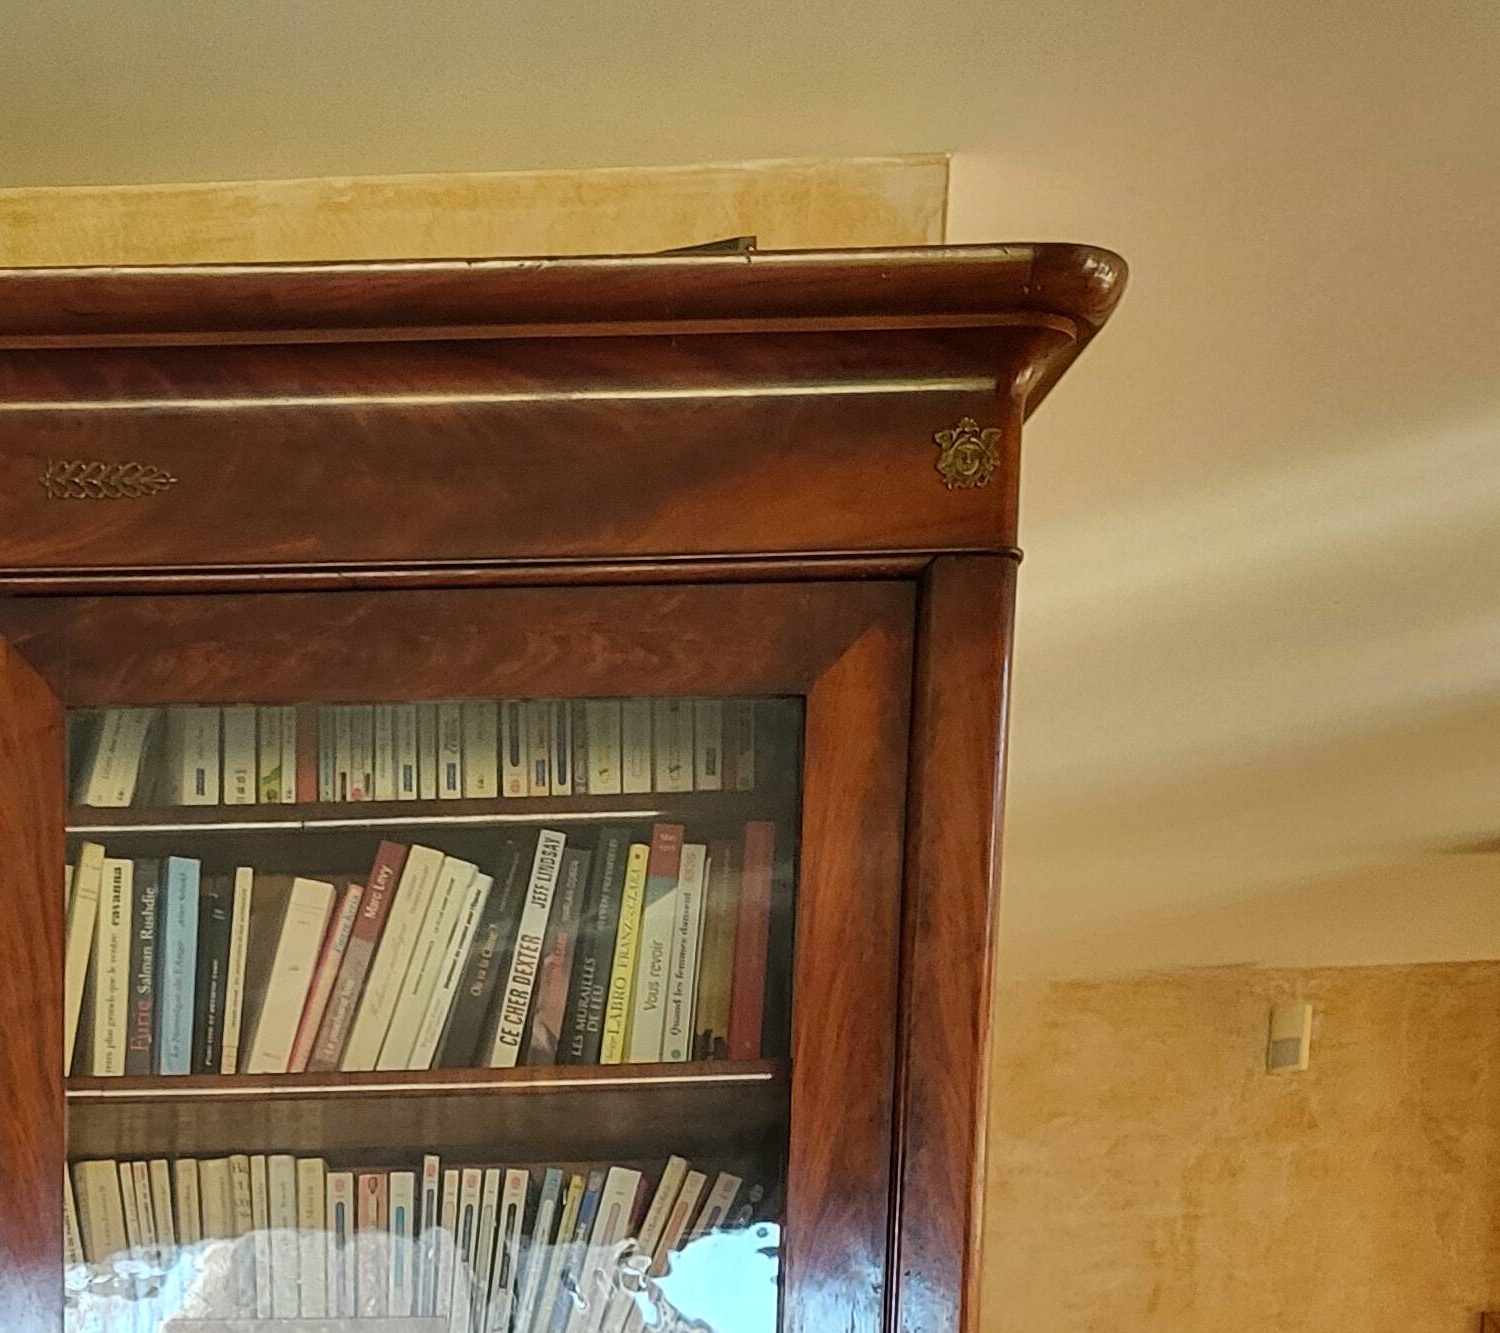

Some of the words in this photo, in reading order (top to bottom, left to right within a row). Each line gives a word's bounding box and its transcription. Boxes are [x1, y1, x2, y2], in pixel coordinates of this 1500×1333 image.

[372, 864, 394, 891] Levy
[534, 836, 561, 883] LINDSAY
[139, 886, 156, 940] Rushdie
[364, 892, 384, 919] Marc
[530, 883, 549, 910] JEFF
[137, 946, 153, 994] Salman
[512, 934, 542, 986] DEXTER
[648, 939, 664, 978] revoir
[503, 989, 530, 1026] CHER
[575, 956, 597, 1031] MURAILLES
[607, 976, 628, 1036] LABRO
[642, 980, 659, 1012] Vous
[129, 999, 151, 1052] Furie
[669, 999, 684, 1037] Quand
[499, 1029, 521, 1047] CE
[571, 1034, 584, 1057] LES
